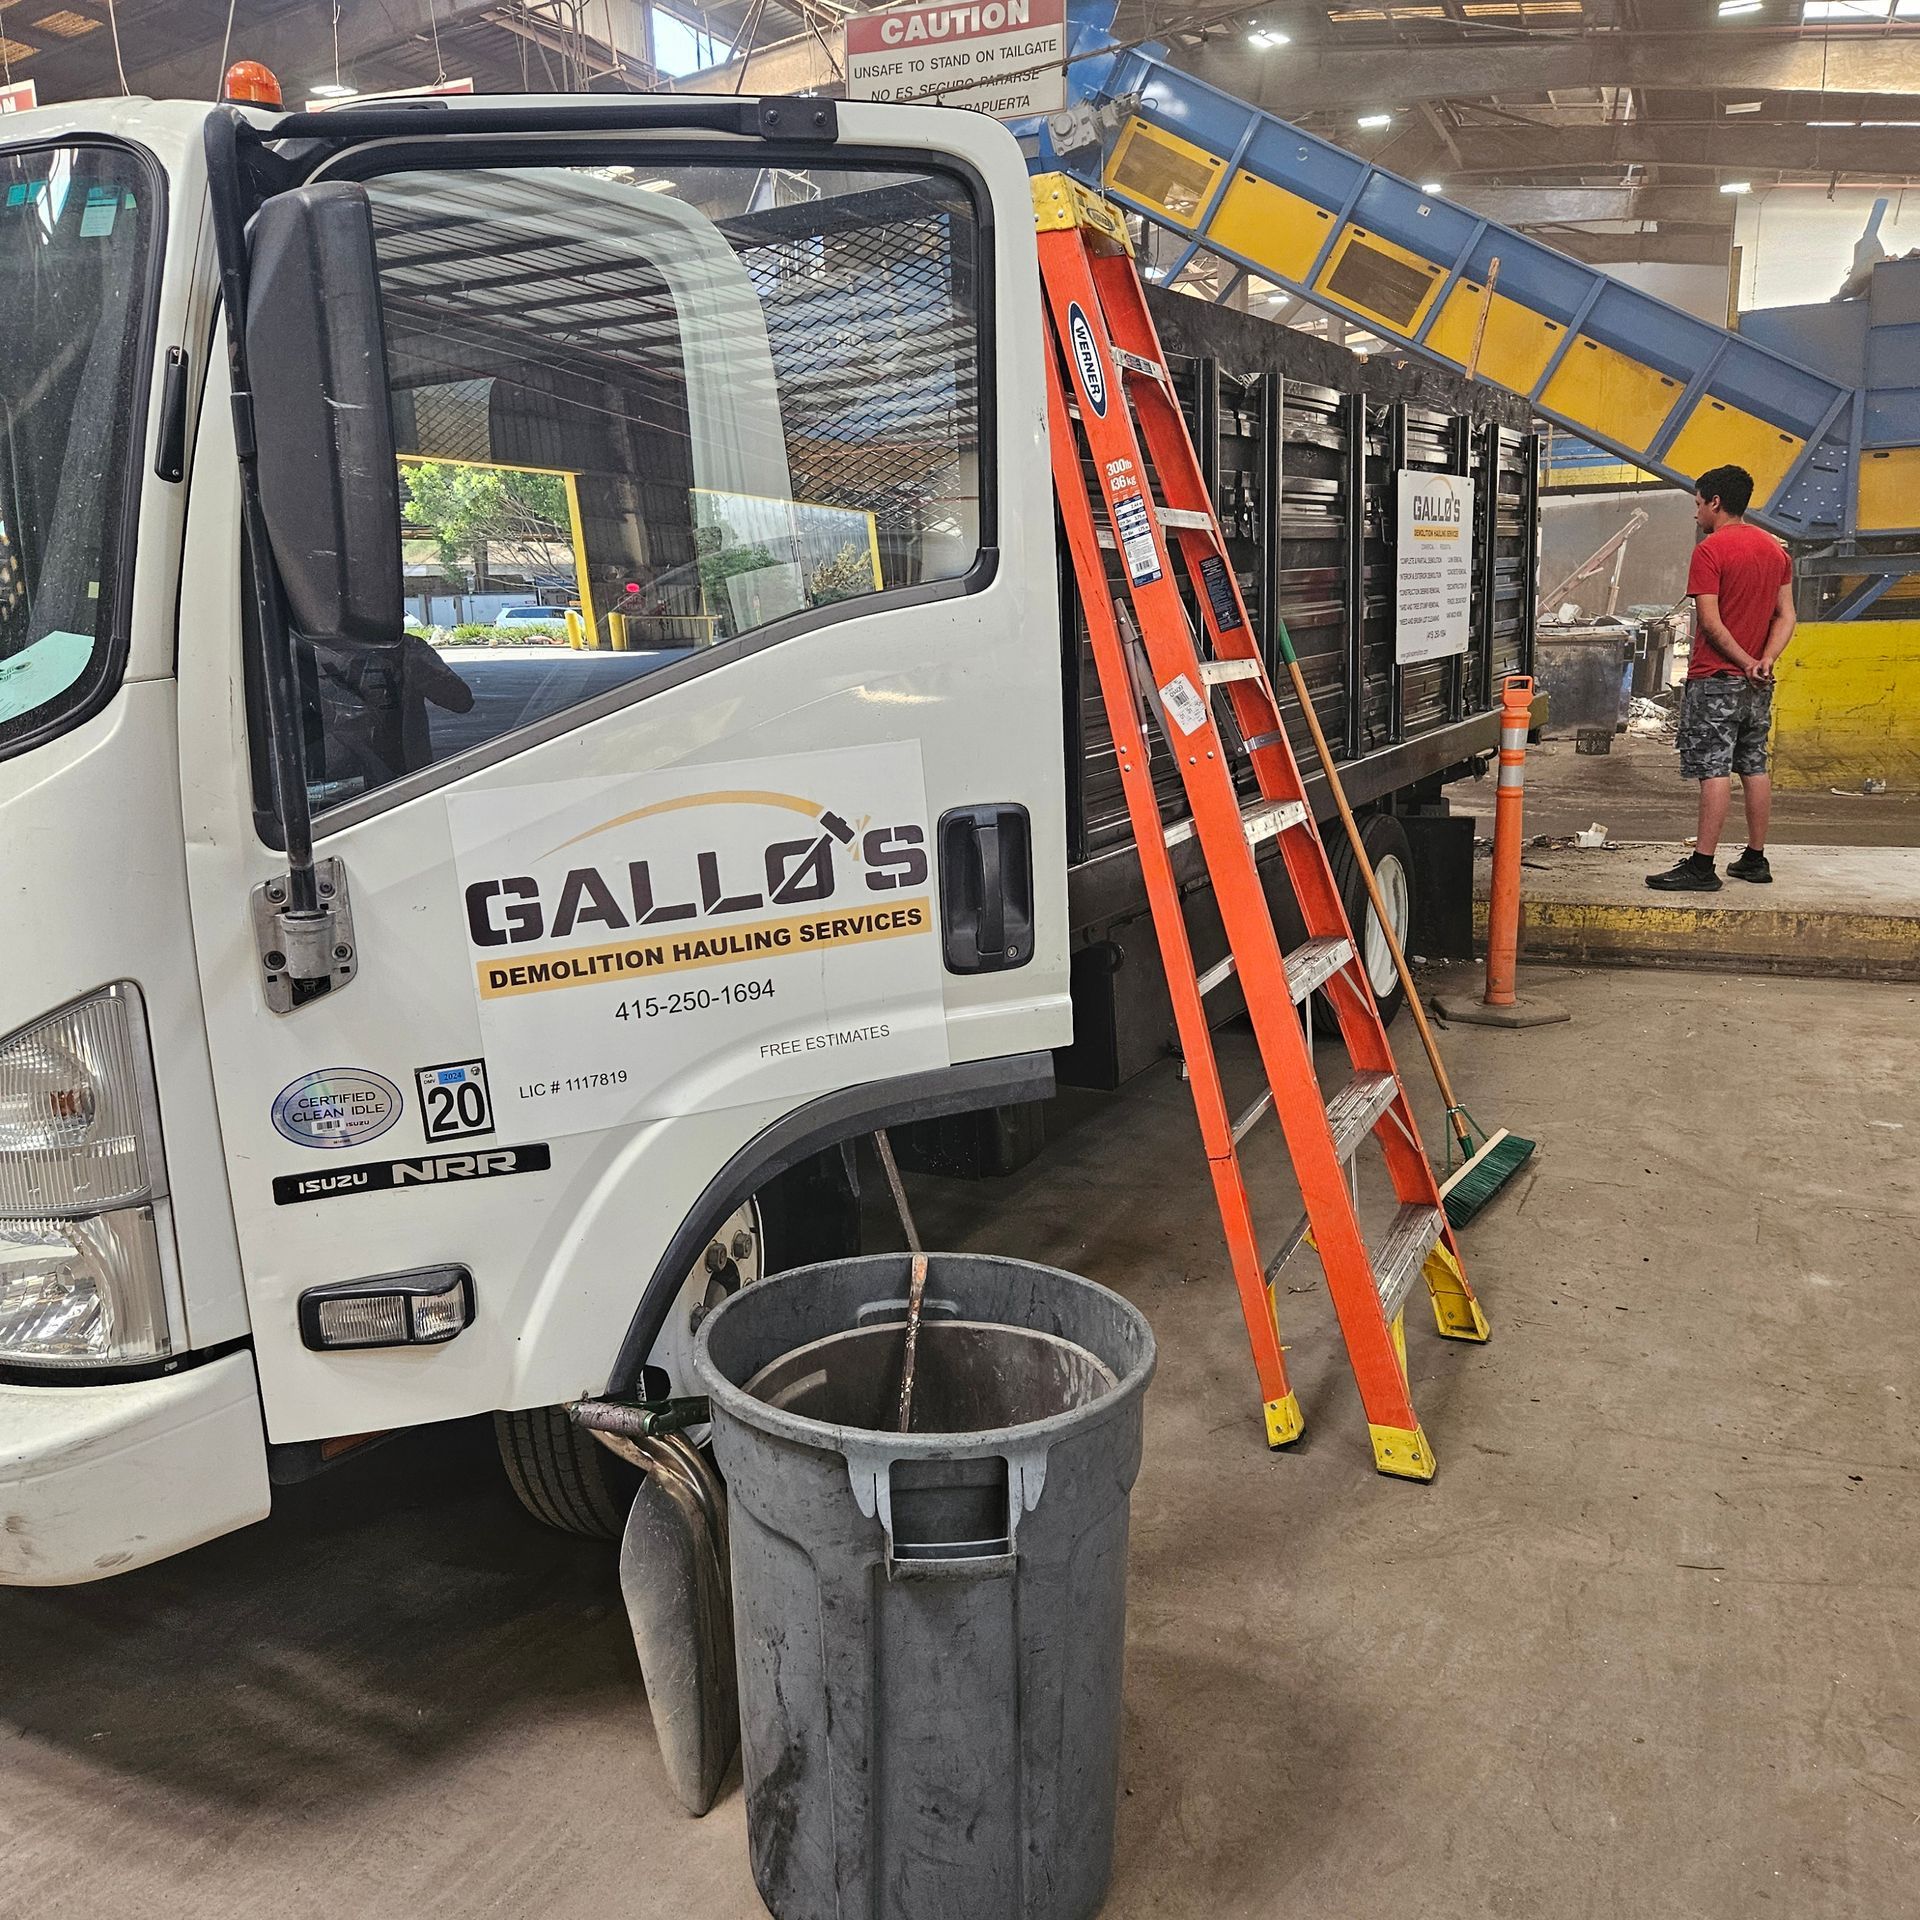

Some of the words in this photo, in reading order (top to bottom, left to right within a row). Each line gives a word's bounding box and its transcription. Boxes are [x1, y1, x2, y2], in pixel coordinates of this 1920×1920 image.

[880, 0, 1029, 44] CAUTION
[854, 63, 903, 79] UNSAFE
[908, 60, 925, 73] TO
[930, 53, 970, 70] STAND
[976, 50, 994, 63] ON
[1000, 39, 1057, 59] TAILGATE
[871, 89, 890, 102] NO
[896, 85, 913, 100] ES
[1075, 326, 1101, 397] WERNER
[1413, 491, 1460, 523] GALLO'S
[465, 812, 928, 947] GALLO'S
[489, 946, 664, 989] DEMOLITION
[673, 928, 791, 962] HAULING
[799, 908, 923, 942] SERVICES
[614, 979, 776, 1022] 415-250-1694
[760, 1039, 802, 1058] FREE
[805, 1025, 890, 1052] ESTIMATES
[443, 1071, 463, 1082] 2024
[519, 1083, 546, 1099] LIC
[550, 1081, 561, 1094] #
[565, 1070, 628, 1092] 1117819
[292, 1106, 344, 1123] CLEAN
[351, 1103, 385, 1116] IDLE
[297, 1091, 376, 1109] CERTIFIED
[427, 1081, 486, 1133] 20
[345, 1119, 370, 1127] ISUZU
[299, 1171, 368, 1194] ISUZU
[391, 1151, 517, 1184] NRR
